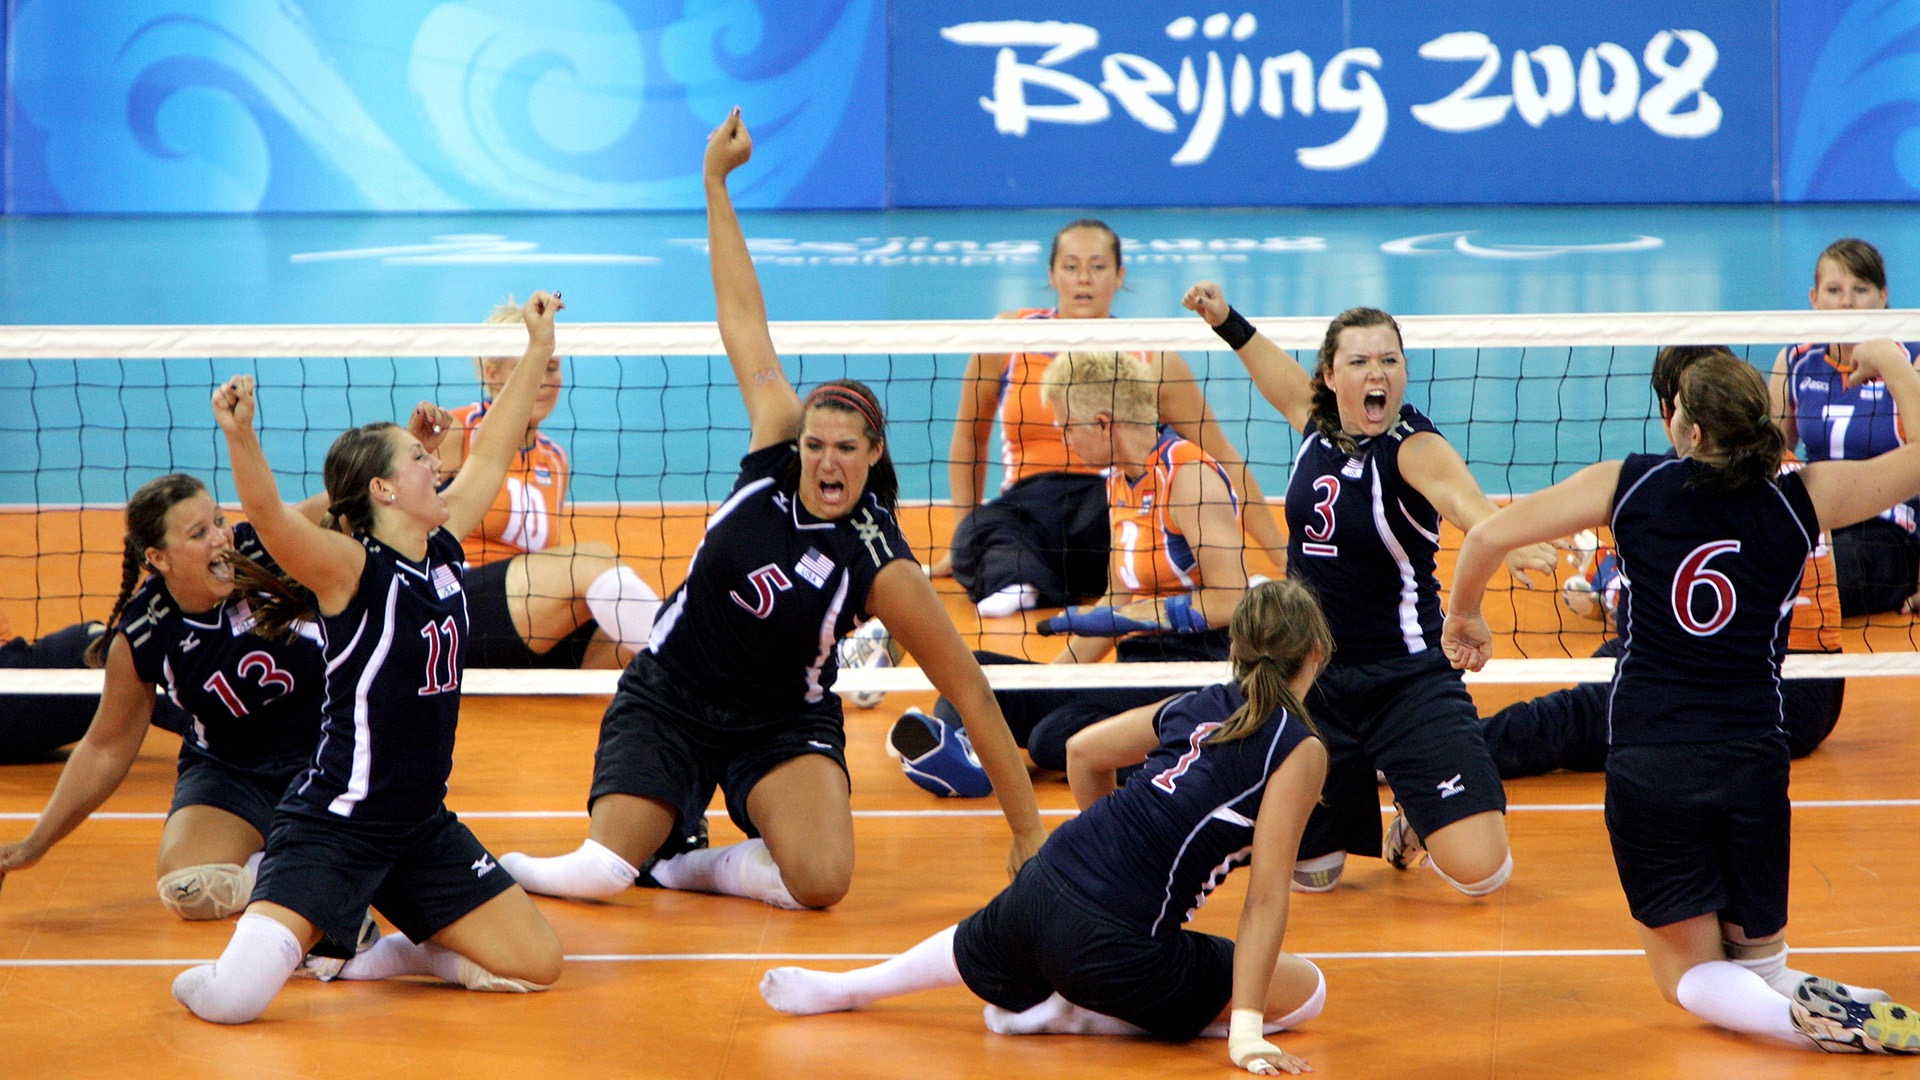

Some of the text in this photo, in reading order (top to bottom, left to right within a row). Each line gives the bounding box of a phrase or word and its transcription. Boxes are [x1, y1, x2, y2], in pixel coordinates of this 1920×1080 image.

[940, 12, 1724, 171] Beijing 2008
[1822, 404, 1855, 460] 7
[501, 478, 549, 552] 10
[1304, 474, 1341, 542] 3
[729, 562, 793, 619] 5
[1671, 539, 1741, 637] 6
[203, 650, 294, 718] 13
[418, 615, 459, 696] 11
[1151, 721, 1225, 795] 1
